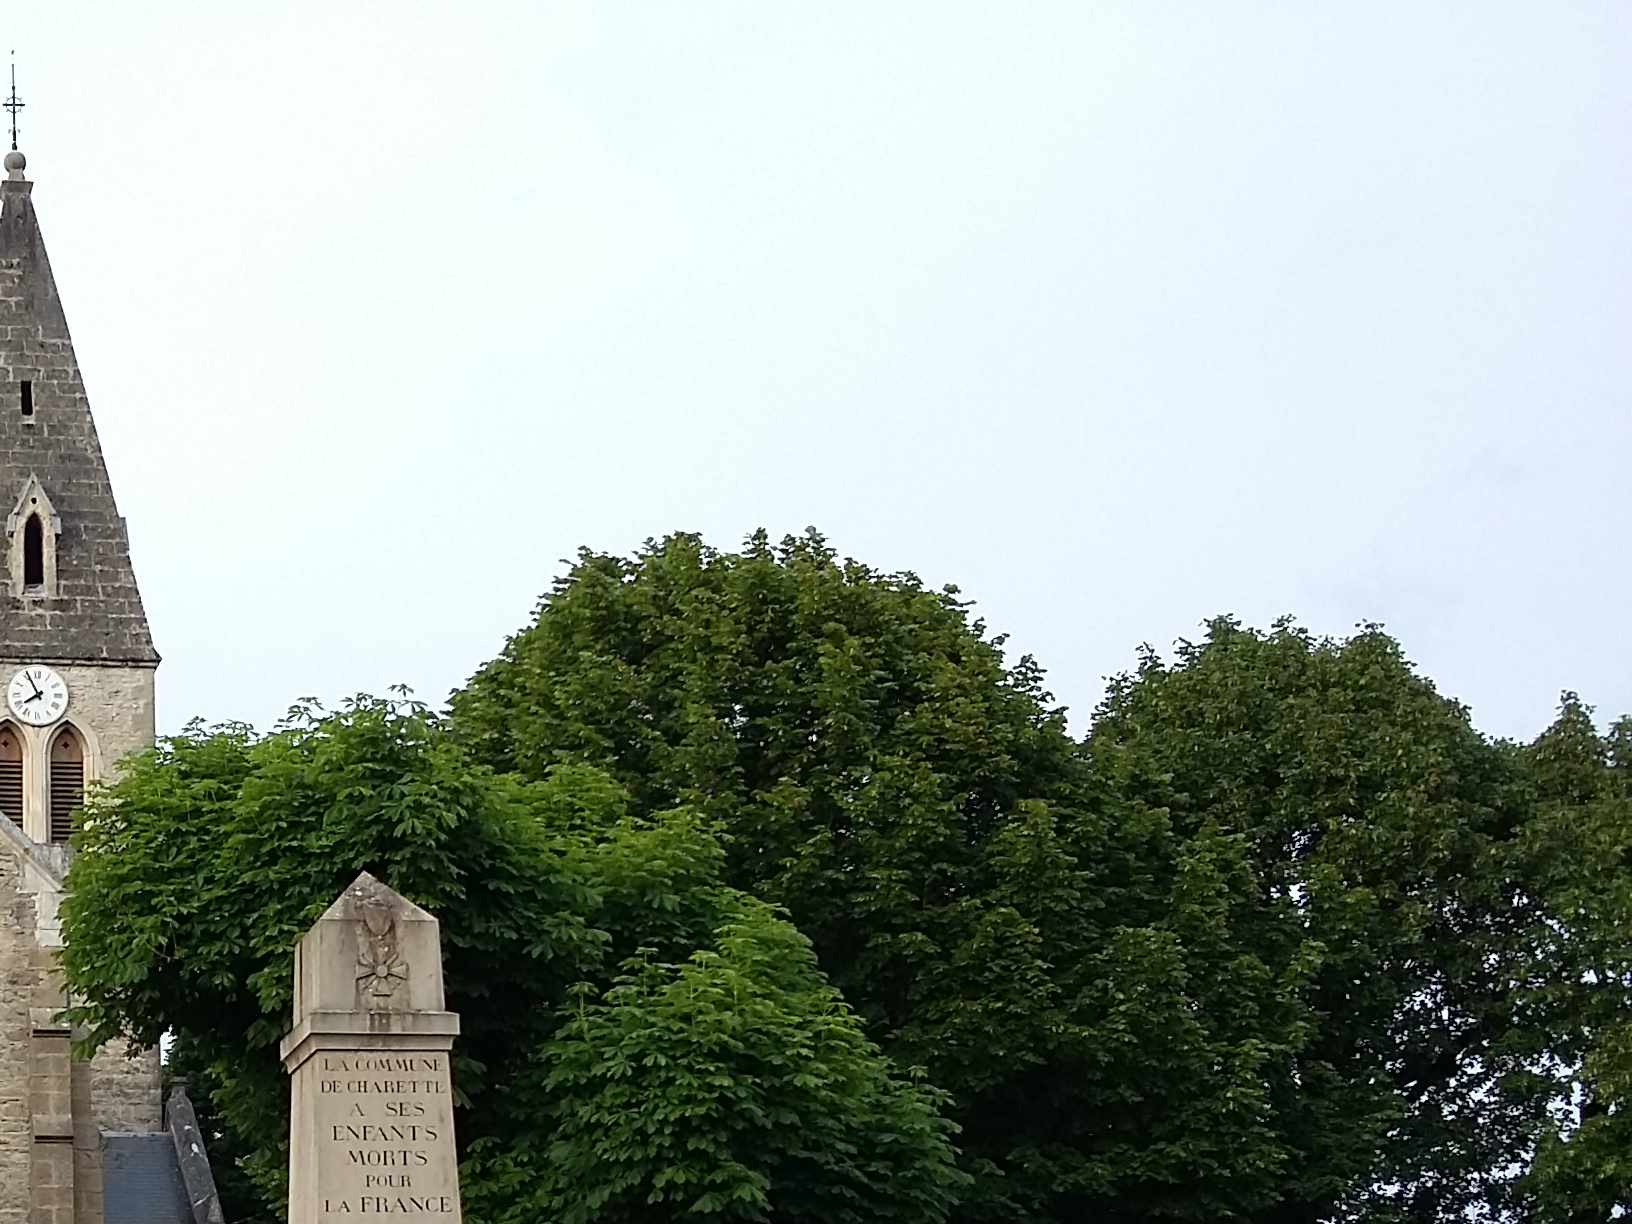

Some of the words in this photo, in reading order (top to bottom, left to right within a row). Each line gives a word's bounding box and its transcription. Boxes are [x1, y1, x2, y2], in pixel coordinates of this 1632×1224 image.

[324, 1058, 350, 1072] LA
[355, 1058, 444, 1072] COMMUNE
[321, 1080, 342, 1093] DE
[347, 1080, 446, 1094] CHARETTE
[349, 1102, 365, 1117] A
[385, 1102, 425, 1117] SES
[332, 1125, 438, 1142] ENFANTS
[345, 1150, 428, 1166] MORTS
[366, 1175, 412, 1188] POUR
[324, 1199, 351, 1213] LA
[360, 1197, 453, 1213] FRANCE
